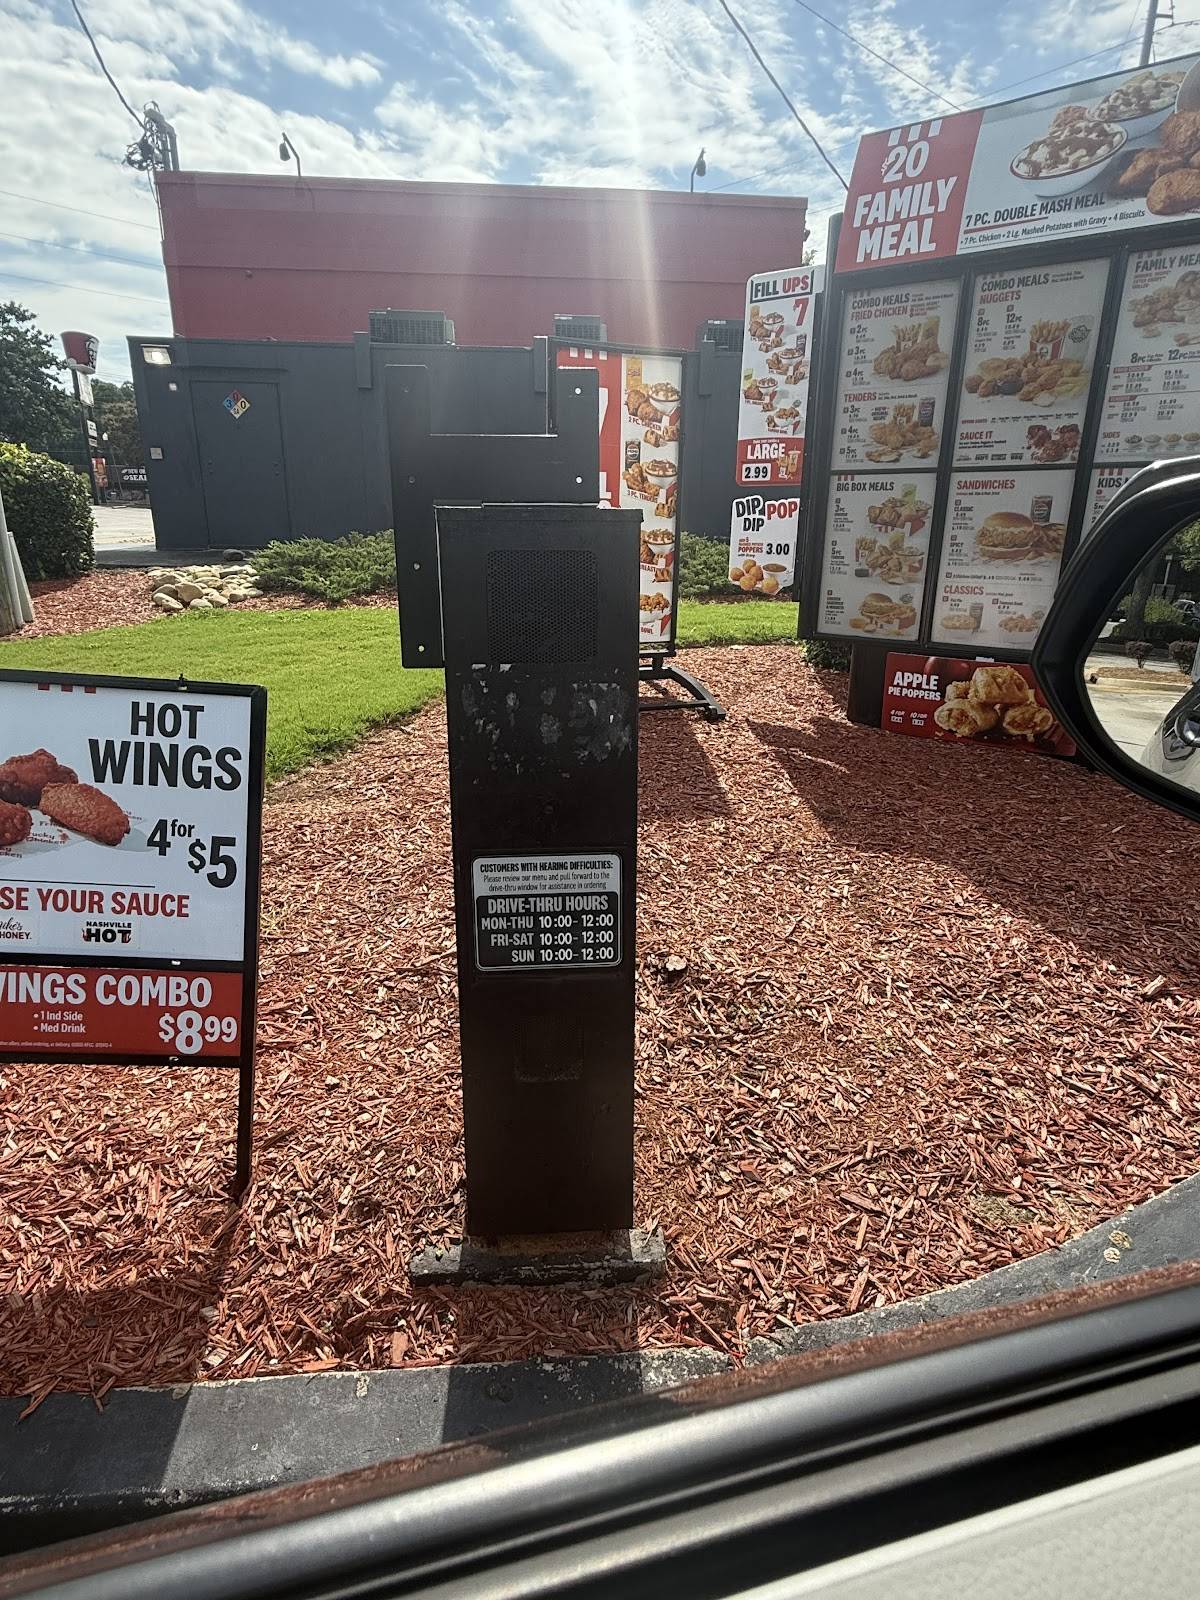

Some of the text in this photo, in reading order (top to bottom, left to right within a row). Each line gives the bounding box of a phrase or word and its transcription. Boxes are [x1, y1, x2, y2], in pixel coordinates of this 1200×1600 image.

[853, 176, 959, 228] FAMILY
[965, 191, 1106, 228] 7 PC. DOUBLE MASH MEAL
[978, 233, 1001, 243] Chicken
[1021, 226, 1044, 237] Mashed
[1045, 222, 1072, 233] Potatoes
[1073, 218, 1088, 229] with
[1088, 215, 1108, 227] Gravy
[1119, 209, 1145, 221] Biscuits
[855, 217, 937, 263] MEAL
[1135, 256, 1177, 272] FAMILY
[754, 274, 810, 298] FILL UPS
[981, 278, 1015, 293] COMBO
[1017, 273, 1050, 288] MEALS
[852, 296, 880, 310] COMBO
[883, 293, 911, 306] MEALS
[980, 290, 1022, 305] NUGGETS
[850, 310, 872, 321] FRIED
[874, 306, 907, 318] CHICKEN
[240, 400, 247, 410] 0
[844, 392, 877, 403] TENDERS
[960, 430, 993, 441] SAUCE IT
[747, 443, 786, 460] LARGE
[744, 466, 768, 479] 2.99
[836, 481, 895, 492] BIG BOX MEALS
[957, 479, 1016, 490] SANDWICHES
[1097, 477, 1121, 488] KIDS
[735, 497, 798, 520] DIP POP
[743, 517, 765, 532] DIP
[766, 543, 790, 556] 3.00
[944, 585, 985, 596] CLASSICS
[893, 671, 939, 690] APPLE
[888, 686, 941, 702] PIE POPPERS
[130, 701, 205, 740] HOT
[88, 738, 242, 792] WINGS
[171, 818, 195, 837] for
[188, 835, 237, 888] $5
[480, 860, 613, 873] CUSTOMERS WITH HEARING DIFFICULTIES:
[484, 874, 501, 883] Please
[549, 873, 559, 881] and
[560, 872, 570, 881] pull
[572, 872, 592, 880] forward
[600, 871, 609, 879] the
[488, 883, 517, 892] drive-thru
[517, 882, 538, 891] window
[539, 882, 547, 890] for
[548, 881, 576, 890] assistance
[583, 881, 606, 891] ordering
[37, 888, 104, 914] YOUR
[111, 891, 190, 918] SAUCE
[488, 895, 609, 914] DRIVE-THRU HOURS
[481, 916, 534, 930] MON-THU
[83, 928, 132, 943] HOT
[490, 932, 534, 947] FRI-SAT
[512, 949, 535, 962] SUN
[95, 974, 212, 1008] COMBO
[47, 1010, 61, 1021] Ind
[63, 1010, 83, 1021] Side
[40, 1023, 86, 1033] Med Drink
